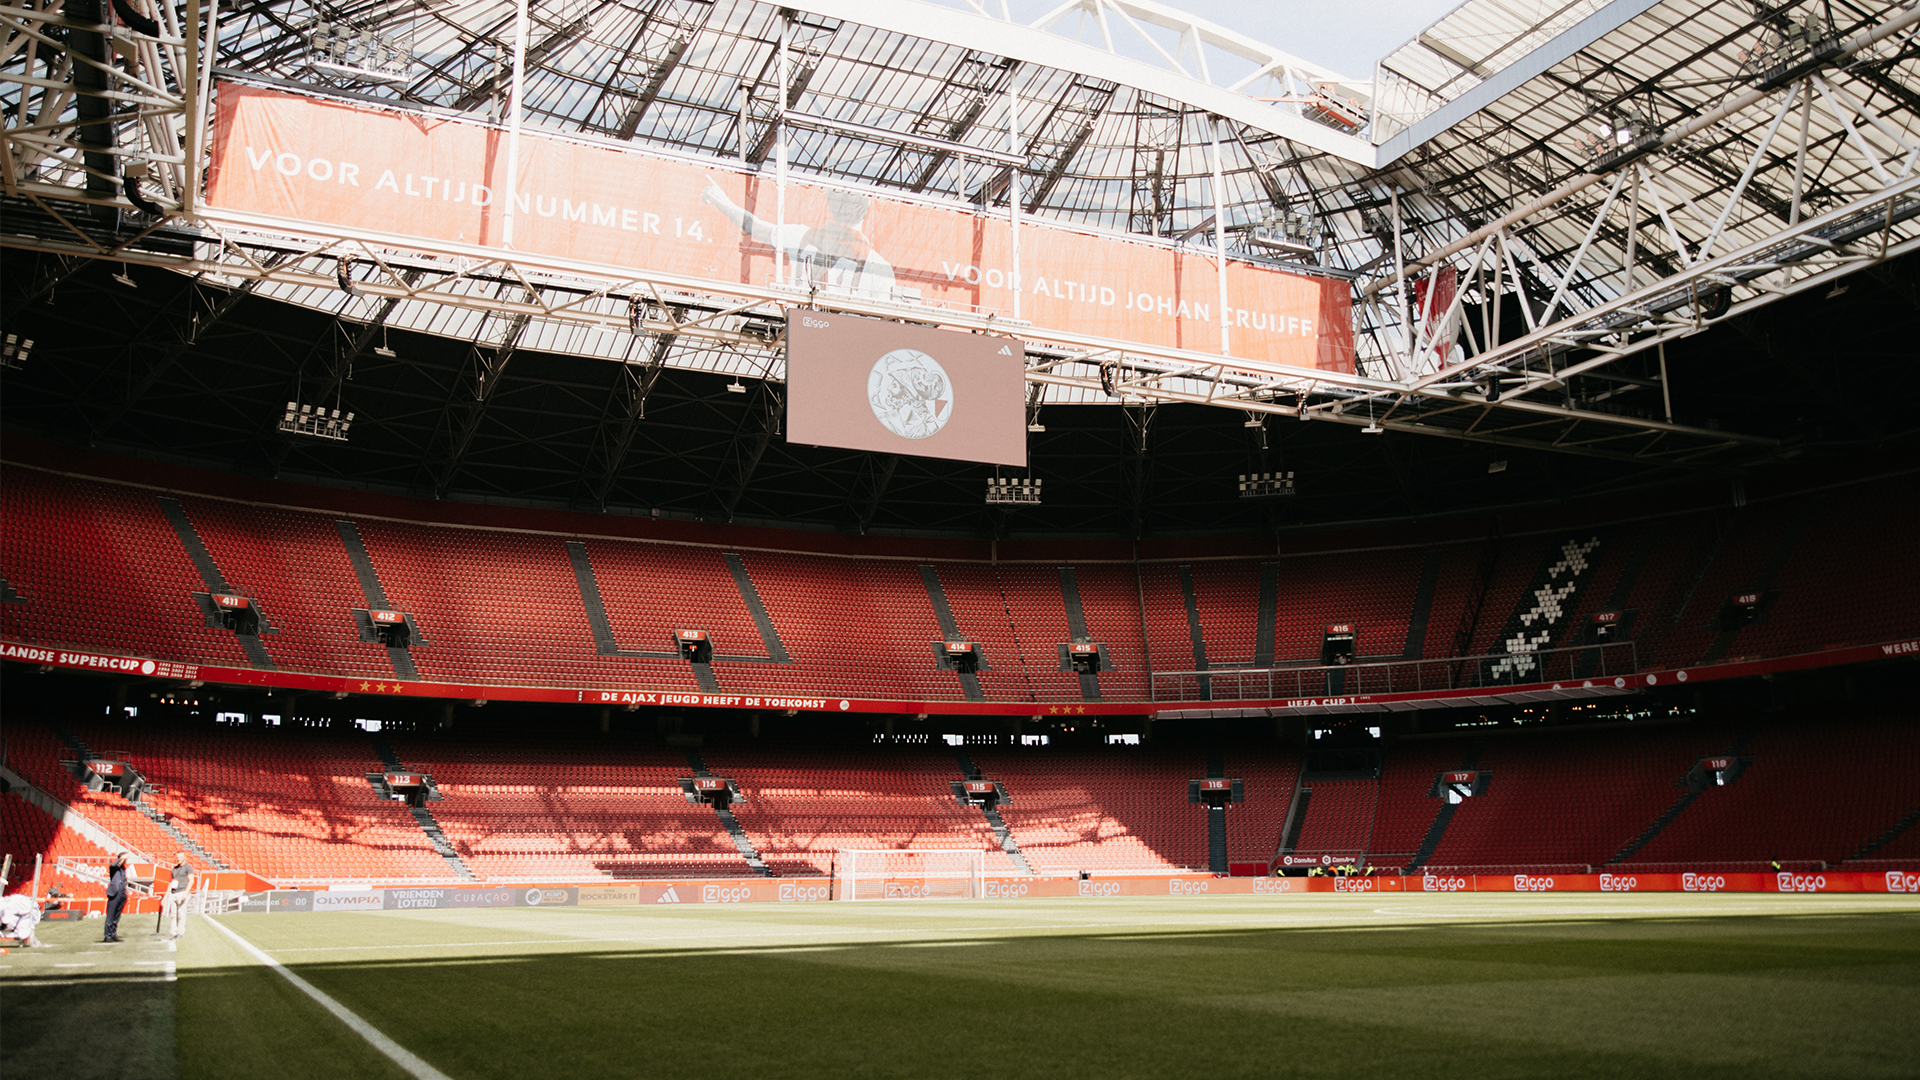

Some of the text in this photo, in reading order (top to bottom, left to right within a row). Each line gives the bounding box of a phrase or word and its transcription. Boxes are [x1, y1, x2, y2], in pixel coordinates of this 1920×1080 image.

[246, 147, 713, 243] VOOR ALTIJD NUMMER 14.
[942, 261, 1022, 292] VOOR
[1033, 276, 1115, 306] ALTIJD
[1125, 291, 1209, 322] JOHAN
[222, 597, 238, 606] 411
[378, 612, 395, 621] 412
[1599, 613, 1615, 621] 417
[682, 631, 698, 639] 413
[1882, 640, 1920, 655] WERE
[59, 652, 139, 671] SUPERCUP
[601, 692, 826, 708] DE AJAX JEUGD HEEFT DE TOEKOMST
[1288, 699, 1317, 707] UEFA
[1322, 698, 1346, 706] CUP
[96, 764, 113, 774] 112
[395, 775, 410, 784] 113
[1454, 773, 1468, 781] 117
[702, 780, 716, 788] 114
[392, 889, 443, 899] VRIENDEN
[580, 892, 636, 901] ROCKSTARS IT
[244, 898, 280, 906] Heineen
[316, 896, 381, 905] OLYMPIA
[397, 898, 436, 908] LOTERIJ
